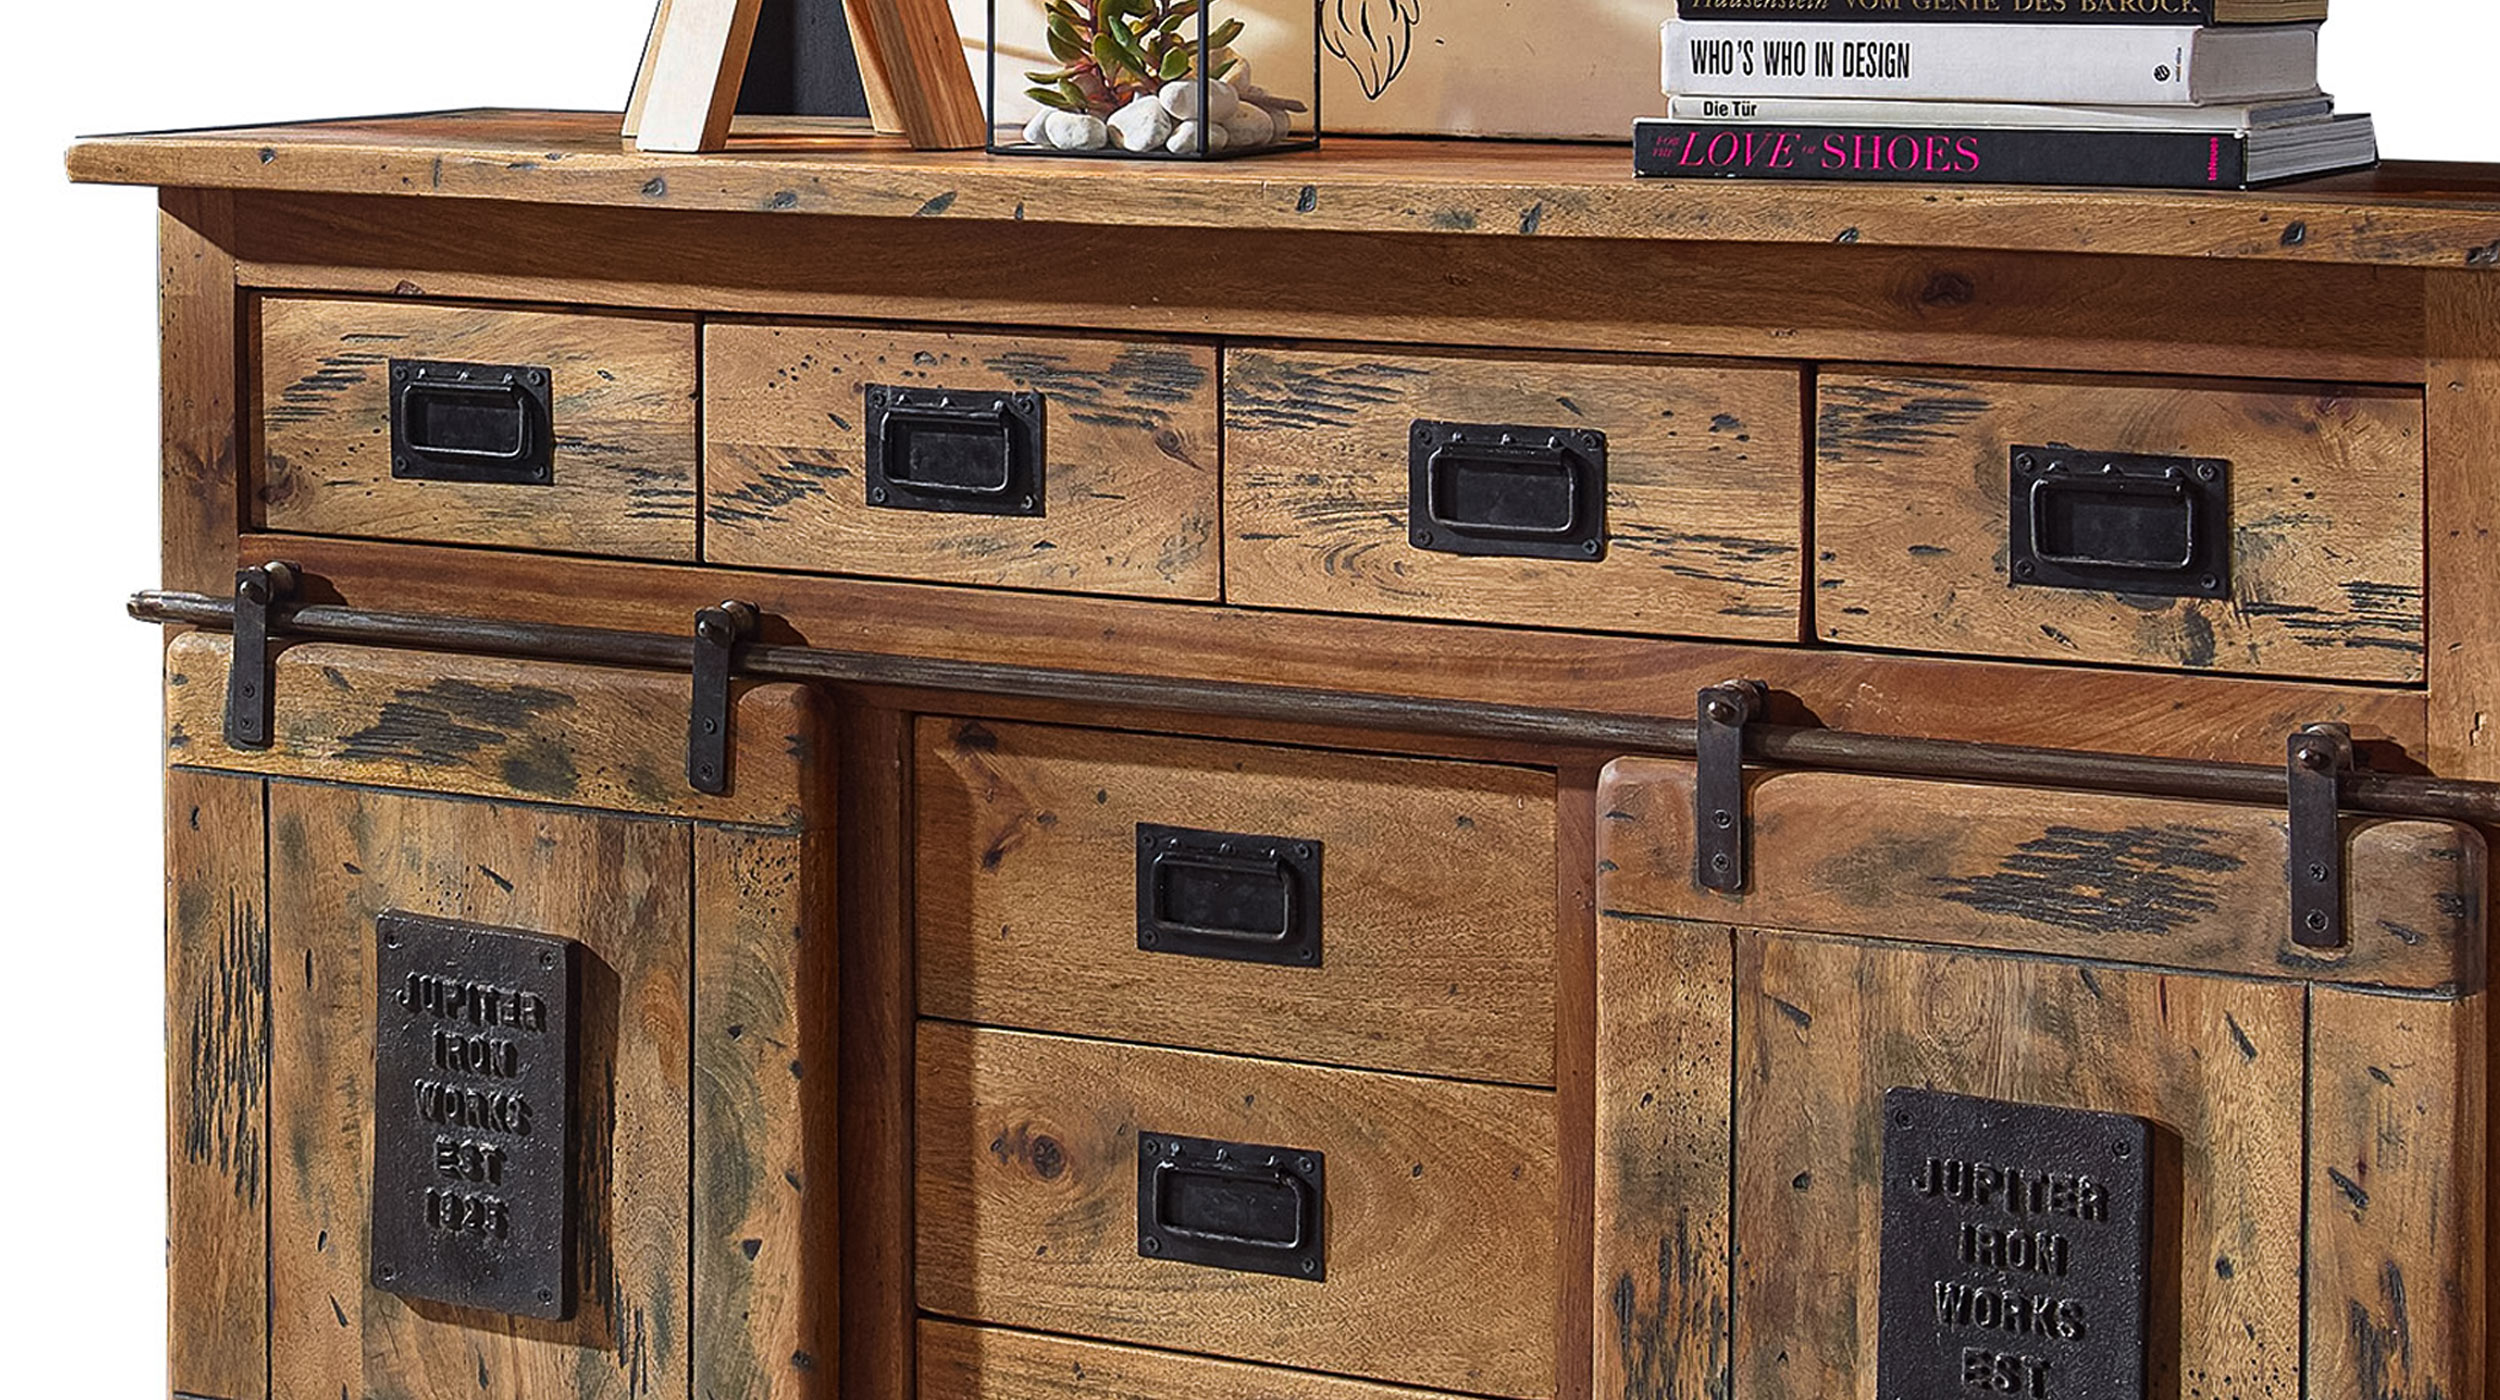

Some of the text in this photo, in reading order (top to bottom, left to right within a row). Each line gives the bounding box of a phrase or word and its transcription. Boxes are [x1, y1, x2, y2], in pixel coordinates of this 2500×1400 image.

[1912, 0, 2000, 11] GENIE
[2013, 0, 2066, 12] DES
[2080, 0, 2200, 13] BAROCK
[1691, 39, 1910, 78] WHO'S WHO IN DESIGN
[1703, 101, 1757, 117] Die Tür
[1677, 131, 1801, 168] LOVE
[1821, 133, 1981, 172] SHOES
[396, 972, 547, 1033] JUPITER
[433, 1029, 519, 1079] IRON
[413, 1078, 534, 1136] WORKS
[433, 1135, 507, 1187] EST
[1911, 1156, 2108, 1222] JUPITER
[1957, 1221, 2069, 1276] IRON
[1935, 1280, 2086, 1341] WORKS
[1961, 1346, 2053, 1399] EST
